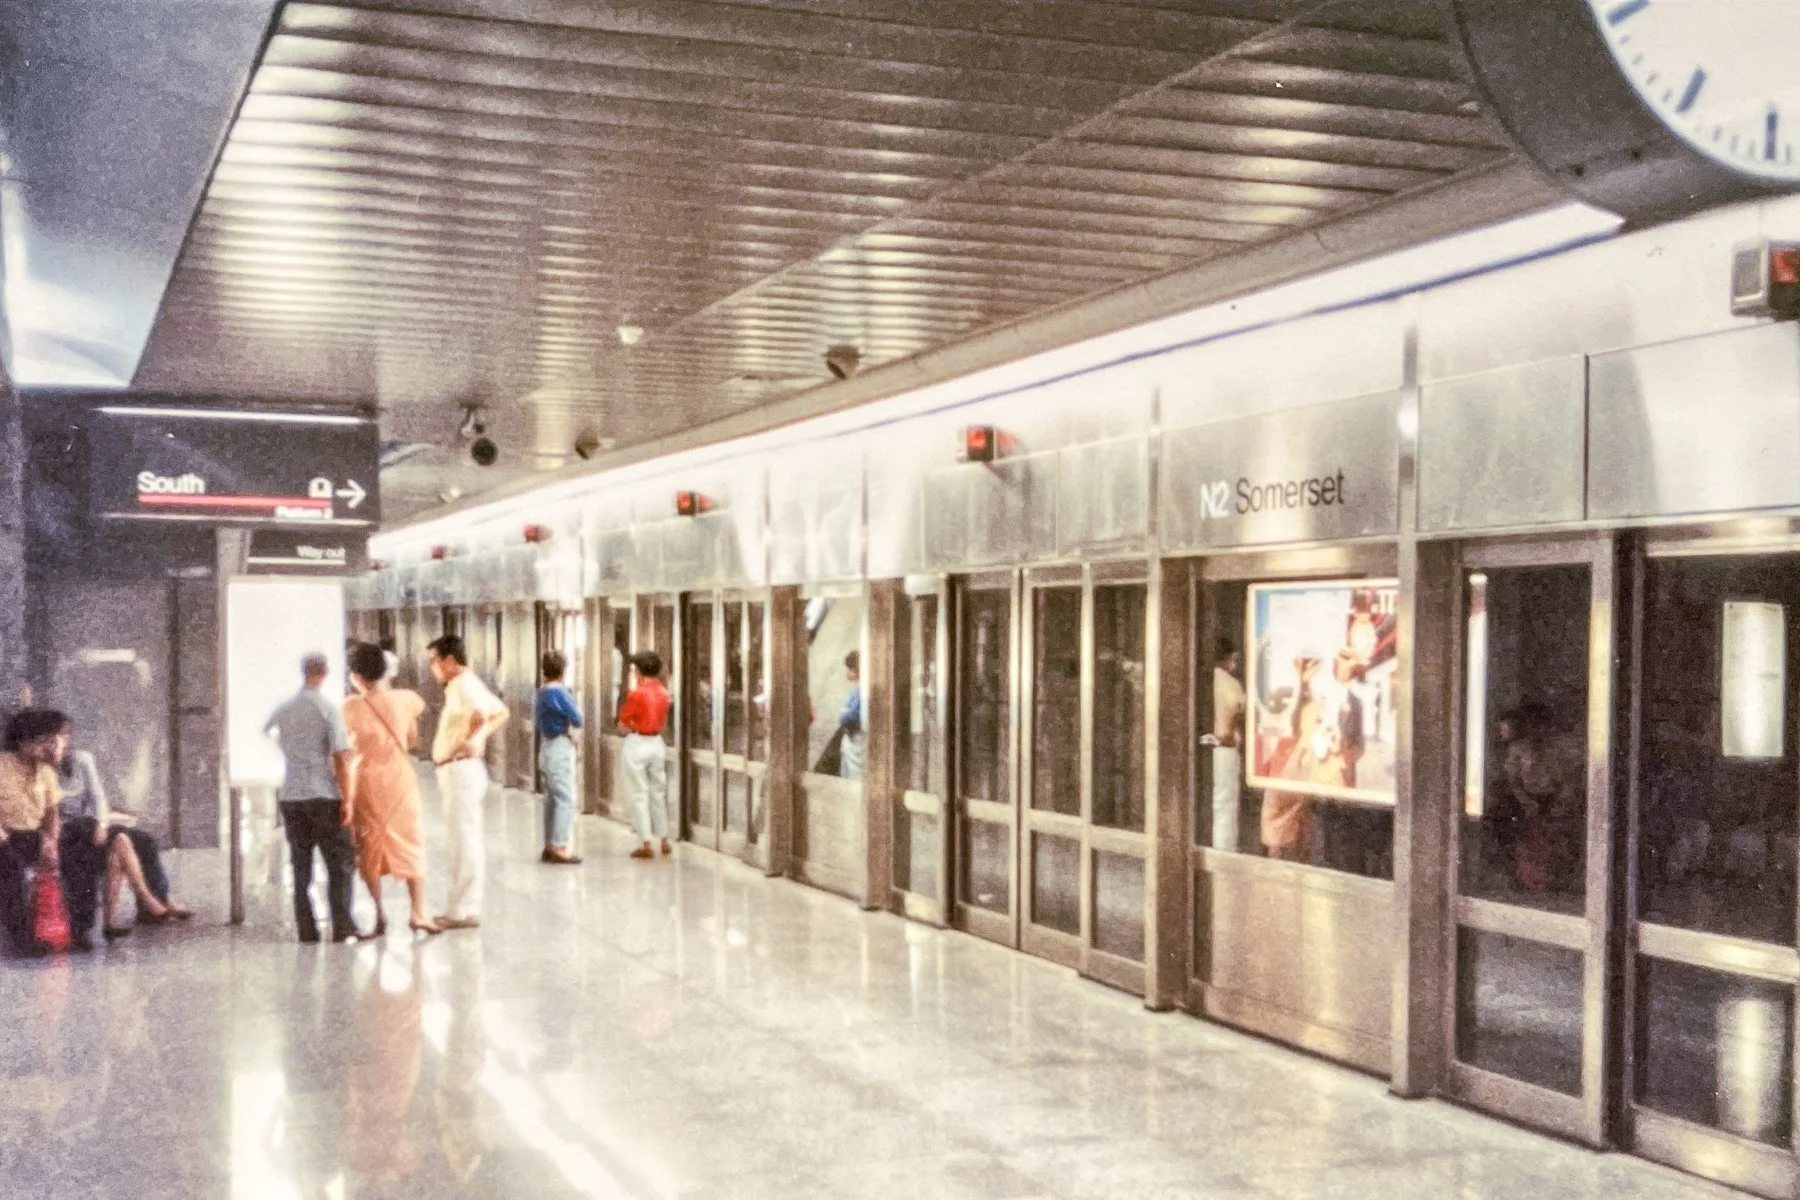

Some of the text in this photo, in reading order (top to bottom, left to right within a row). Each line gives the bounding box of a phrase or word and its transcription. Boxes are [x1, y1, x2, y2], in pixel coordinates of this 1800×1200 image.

[136, 470, 206, 494] South
[1200, 467, 1345, 519] N2 Somerset
